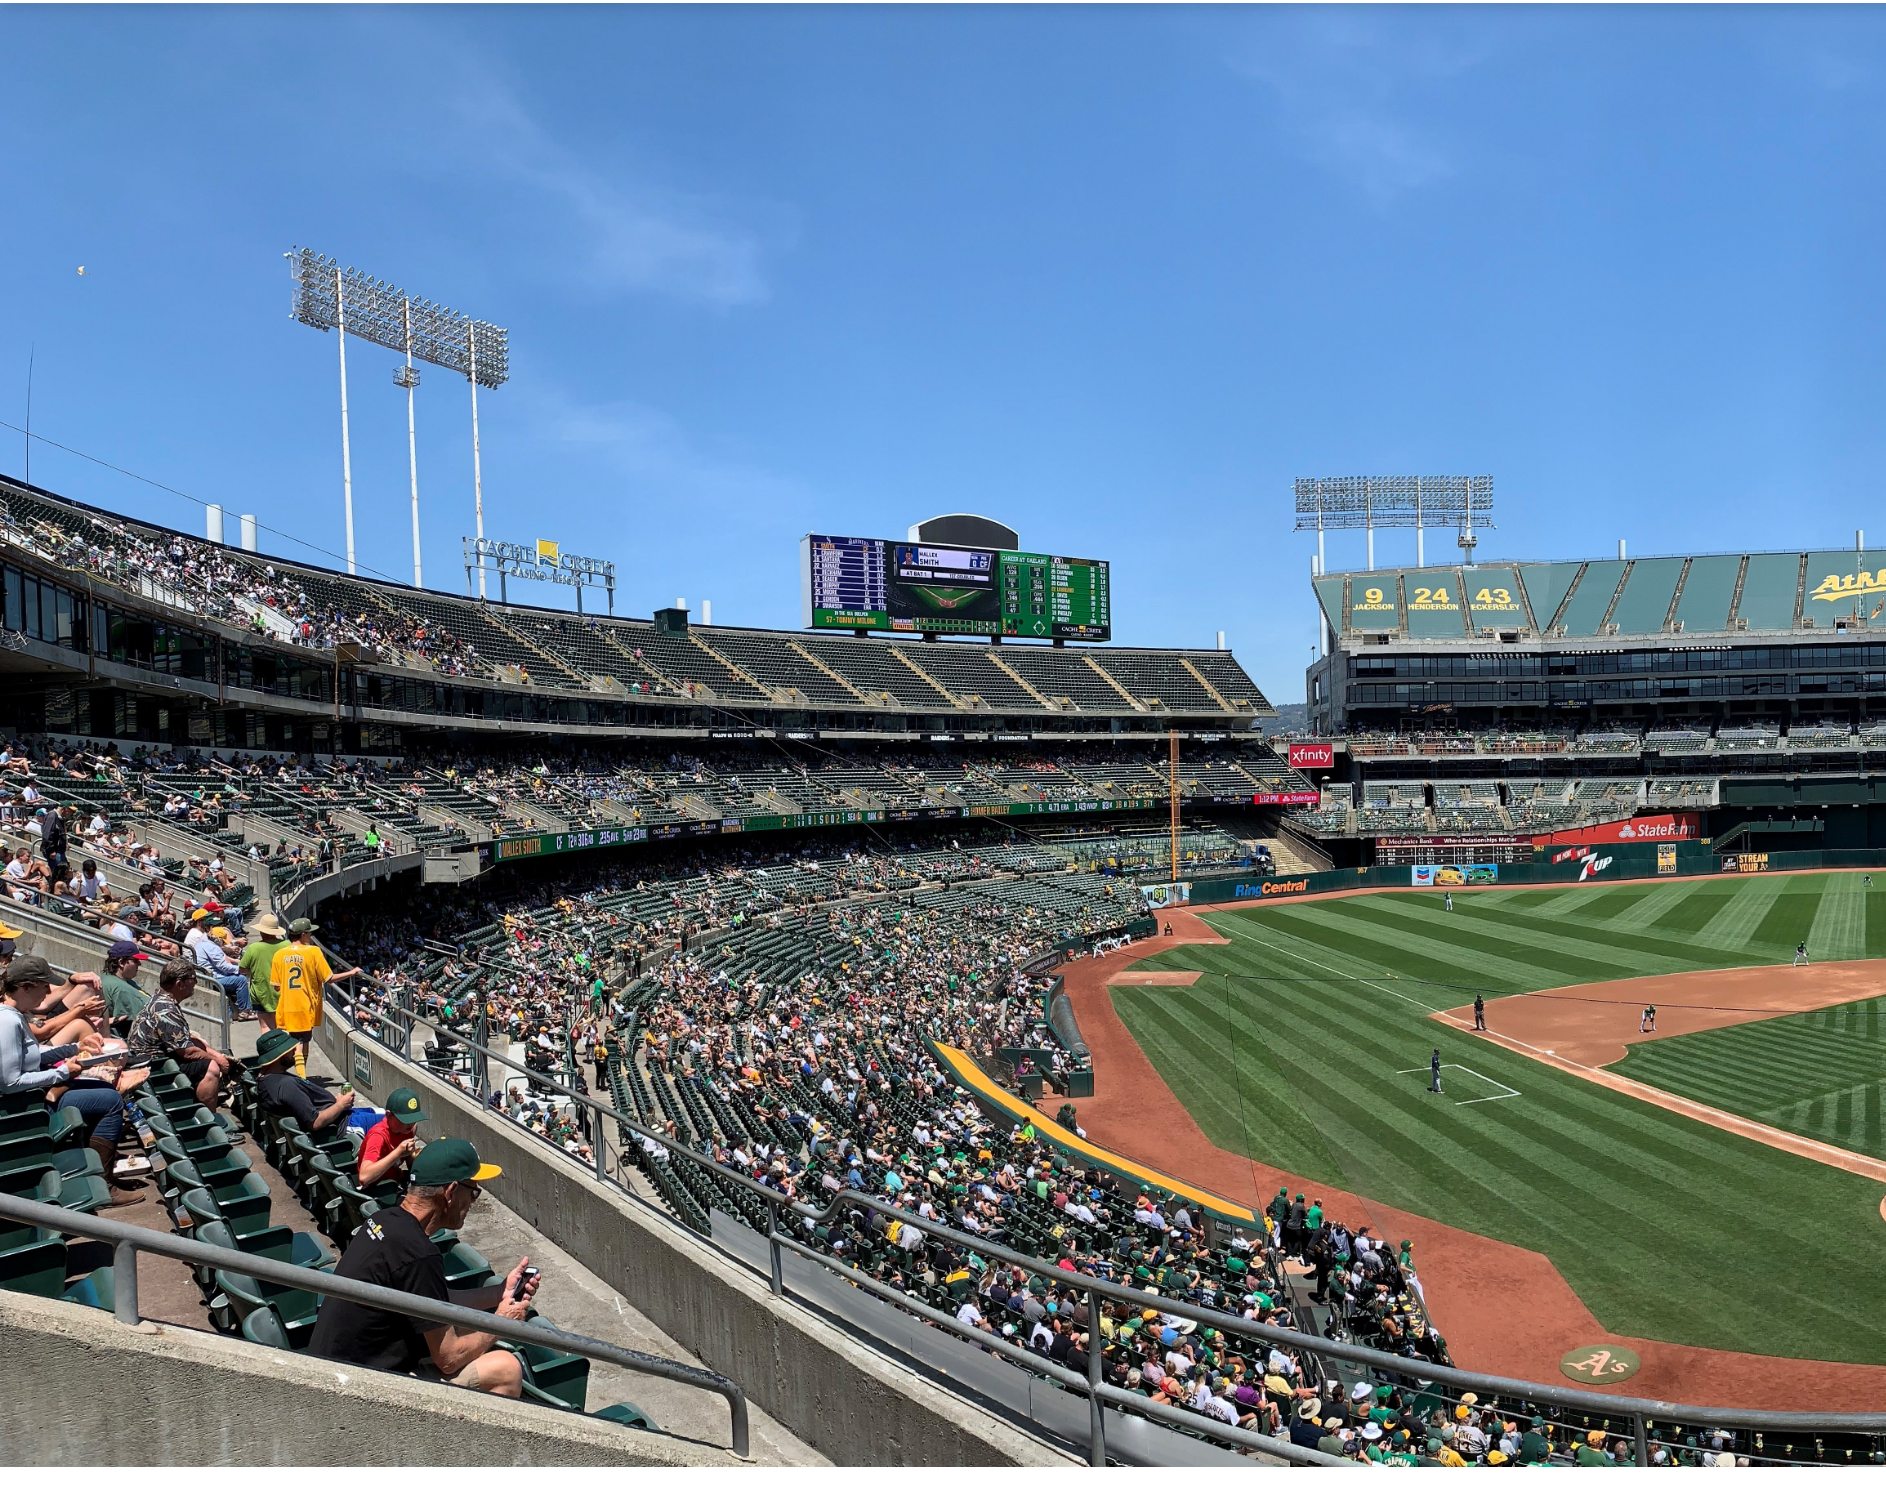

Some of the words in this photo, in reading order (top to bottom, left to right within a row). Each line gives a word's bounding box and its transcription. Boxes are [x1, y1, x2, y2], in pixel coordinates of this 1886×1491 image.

[474, 537, 535, 561] CACHE
[560, 553, 612, 575] CREEK
[920, 558, 939, 566] SMITH
[510, 566, 547, 582] CASINO
[551, 573, 585, 588] RESORT
[1365, 588, 1383, 604] 9
[1414, 587, 1450, 604] 24
[1475, 588, 1512, 604] 43
[1352, 603, 1395, 611] JACKSON
[1408, 603, 1459, 611] HENDERSON
[1470, 603, 1520, 611] ECKERSLEY
[1292, 748, 1331, 763] xfinity
[1258, 795, 1269, 803] 1:12
[1270, 794, 1279, 802] PM
[962, 807, 970, 817] 15
[970, 806, 991, 816] HOMER
[991, 805, 1010, 815] BAILEY
[1048, 803, 1060, 812] 4.71
[847, 813, 856, 822] SEA
[1637, 823, 1696, 837] StateFarm
[498, 842, 502, 859] 0
[502, 839, 523, 858] MALLEX
[523, 838, 542, 856] SMITH
[556, 835, 563, 850] CF
[1738, 853, 1769, 863] STREAM
[1579, 852, 1613, 882] 7UP
[1738, 862, 1759, 872] YOUR
[1154, 888, 1166, 898] 811
[1235, 878, 1308, 898] RingCentral
[284, 955, 304, 964] DAVIS
[288, 966, 302, 990] 2
[1564, 1350, 1630, 1377] A's
